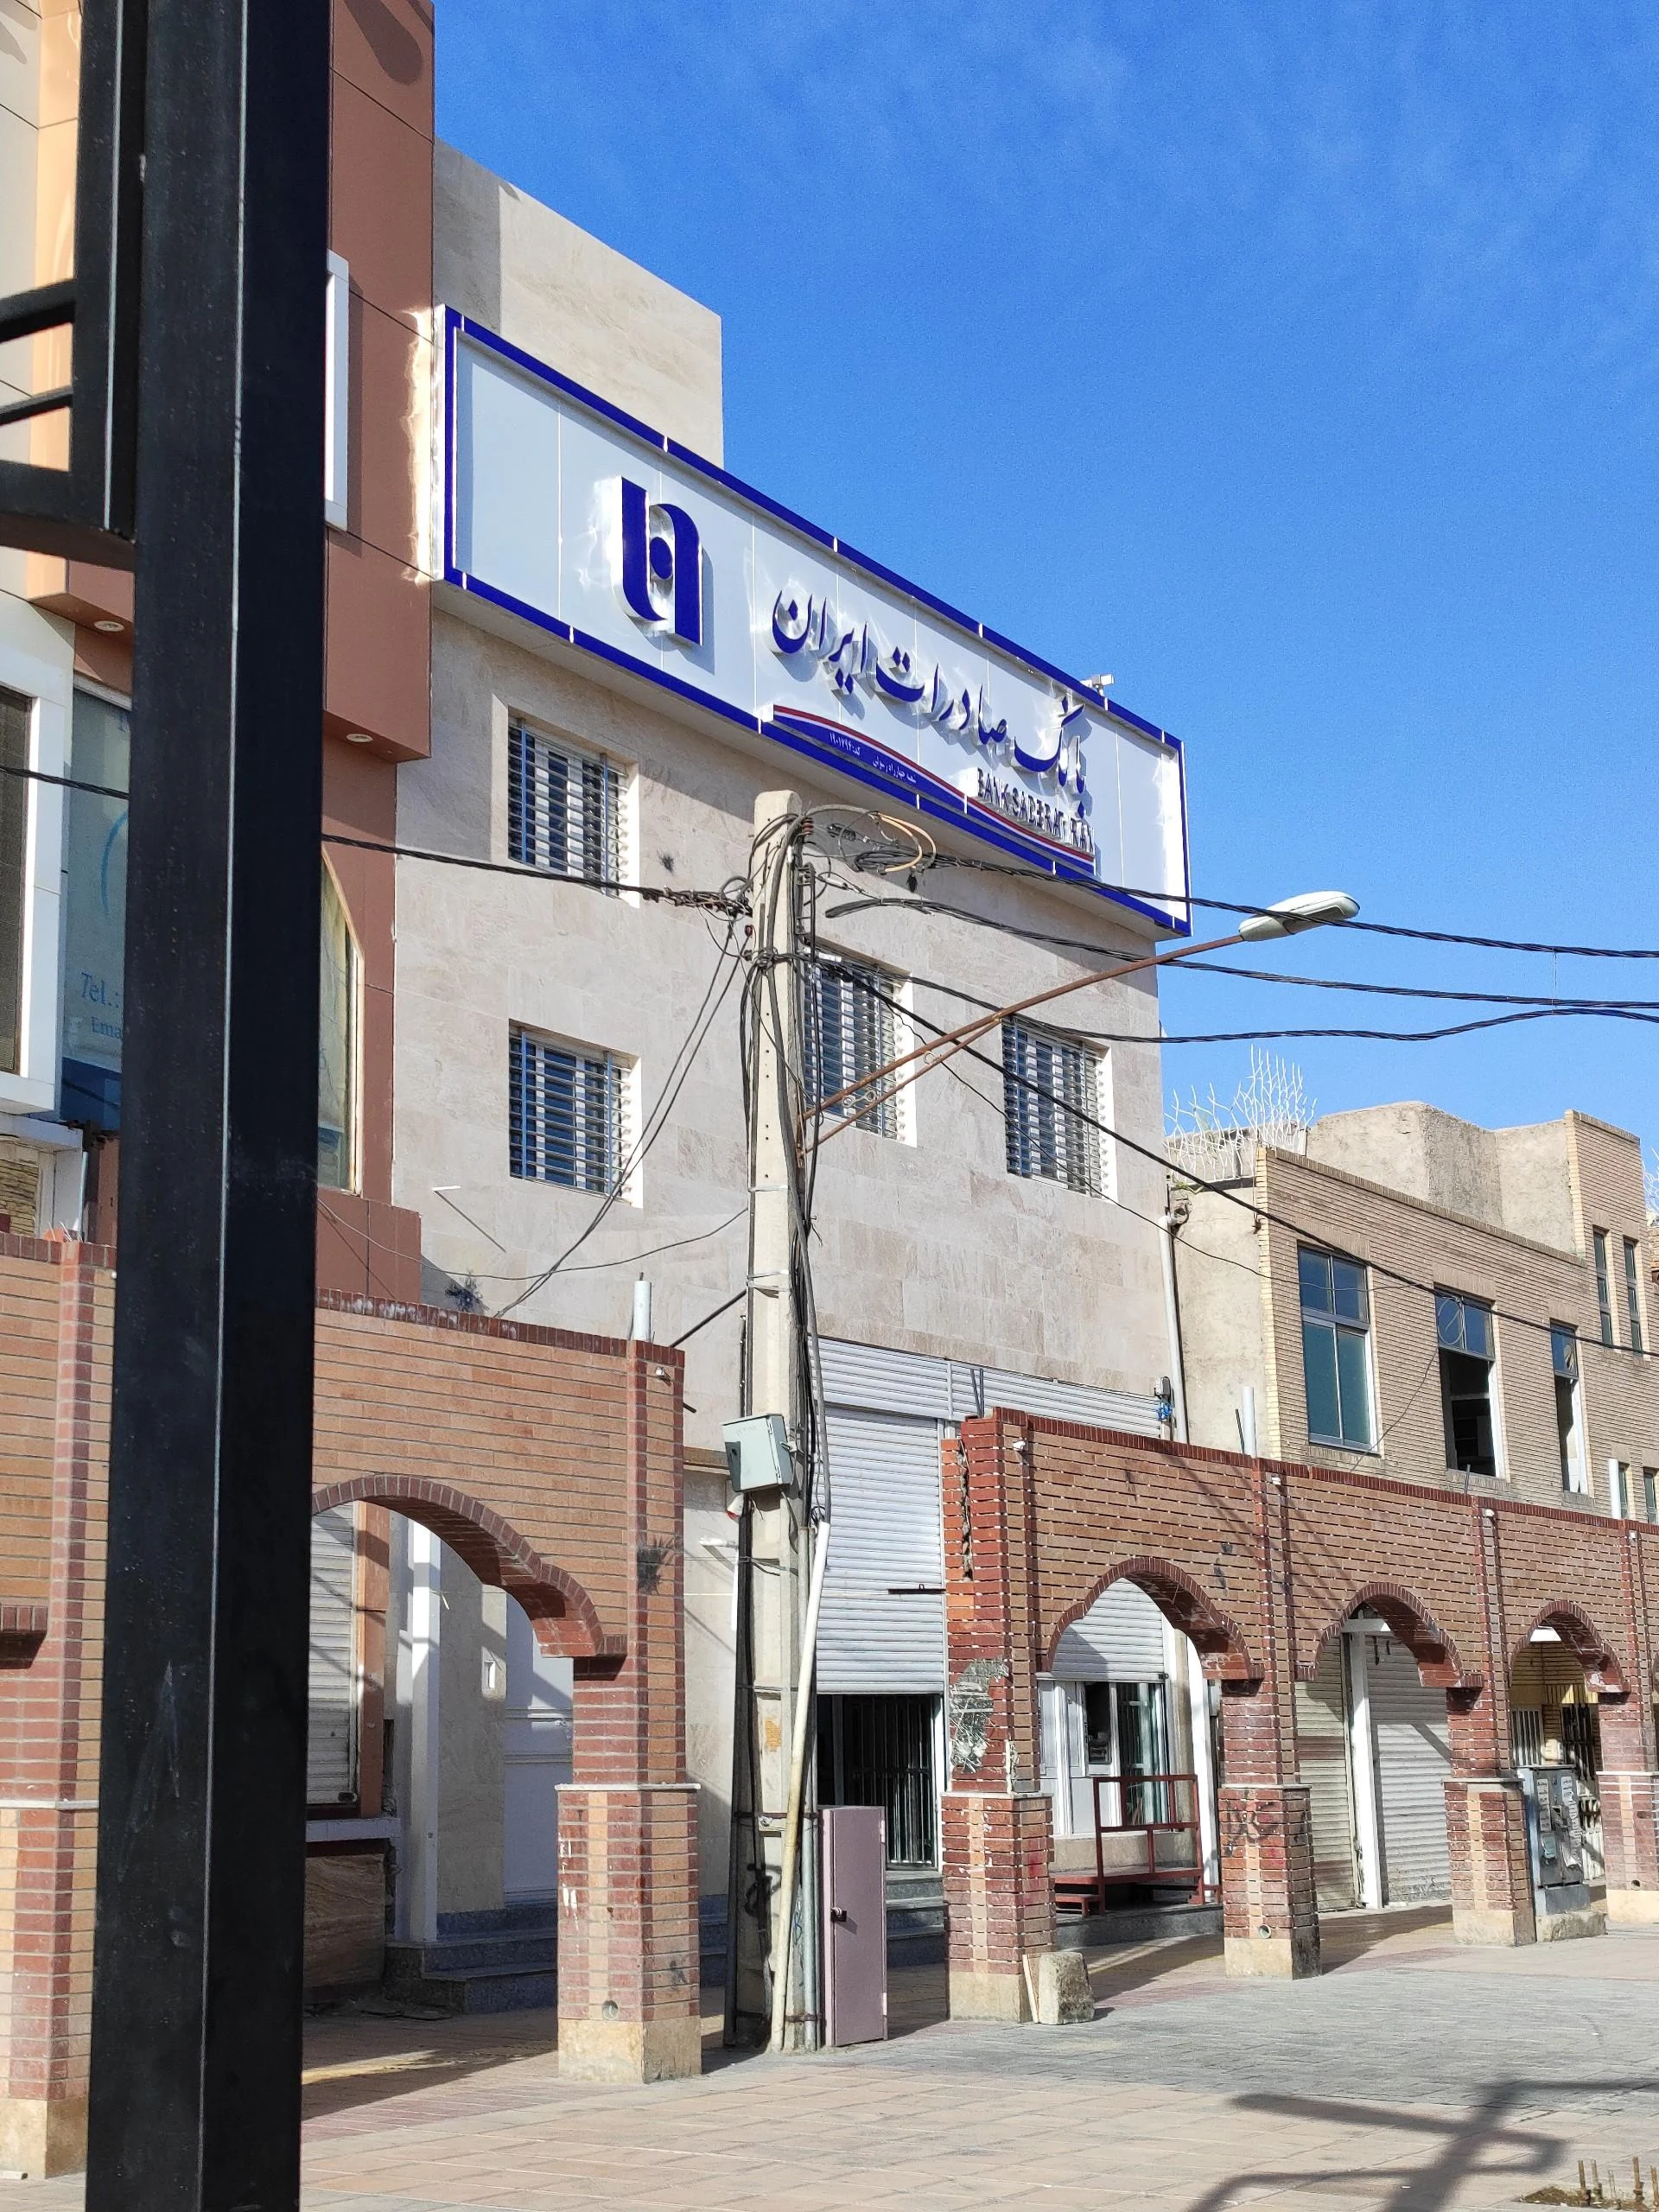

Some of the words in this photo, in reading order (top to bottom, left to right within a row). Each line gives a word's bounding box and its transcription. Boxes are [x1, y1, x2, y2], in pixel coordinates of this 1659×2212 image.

[772, 589, 869, 695] ایران
[875, 646, 1007, 745] صادرات
[977, 767, 1010, 812] BANK
[1012, 787, 1064, 838] SADERAT
[1014, 695, 1085, 819] بانک
